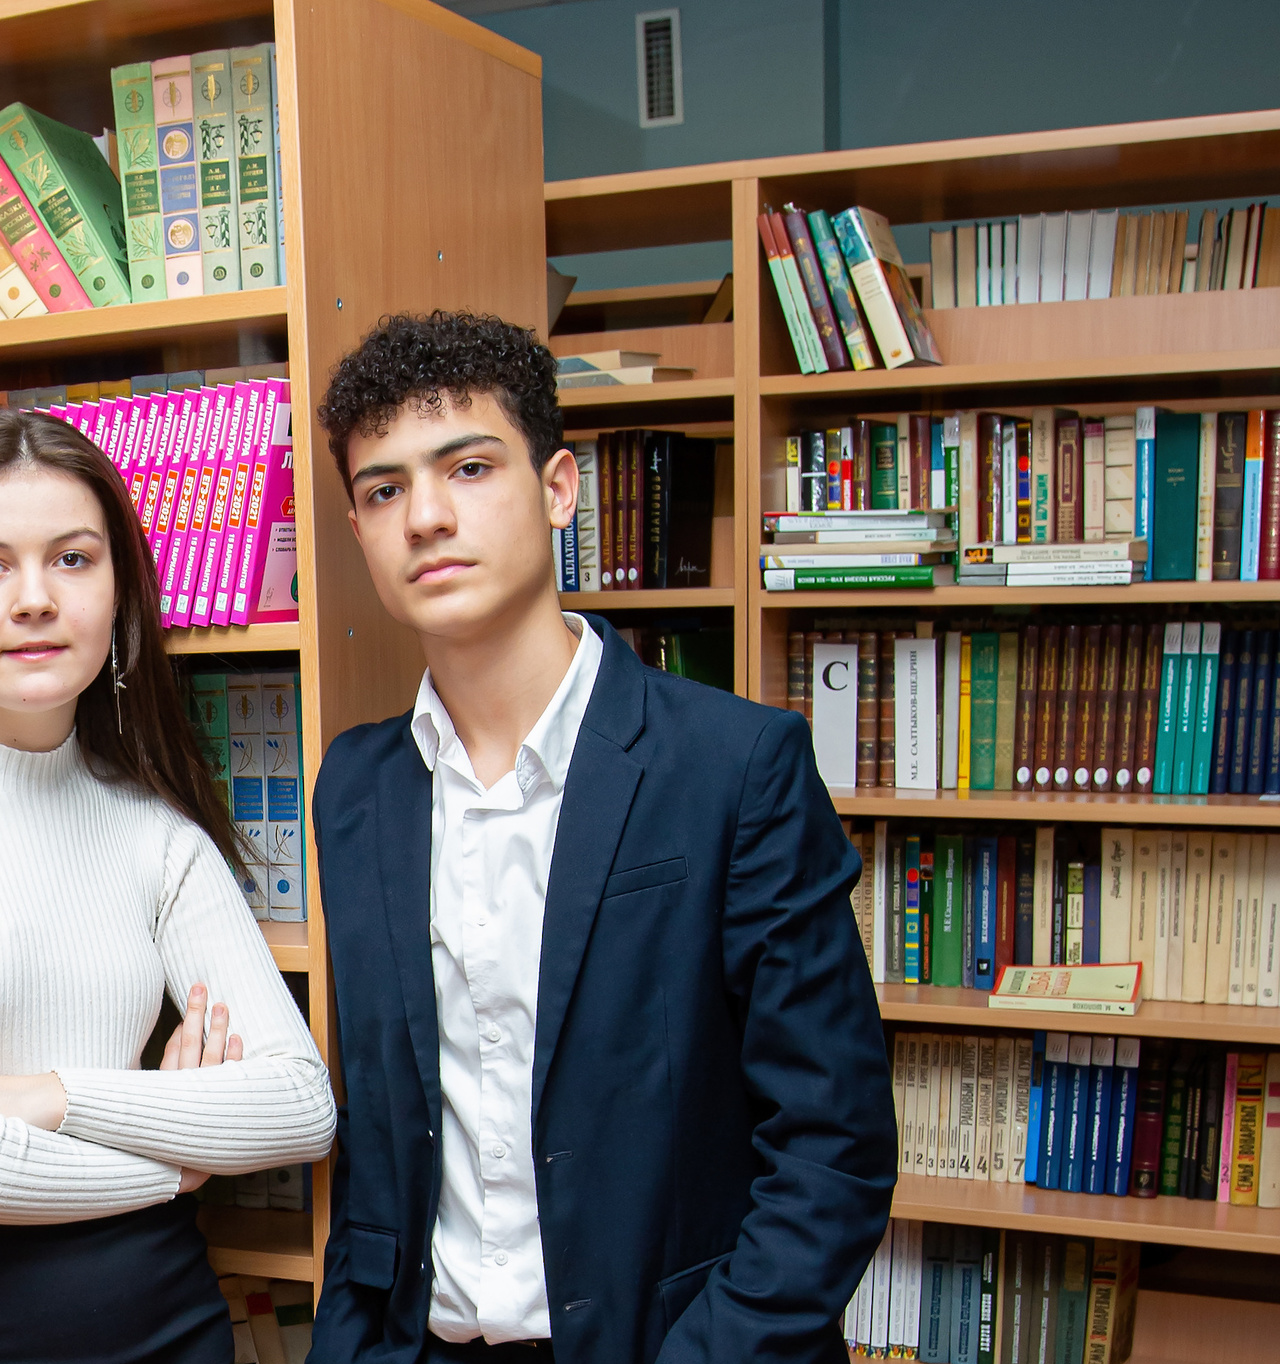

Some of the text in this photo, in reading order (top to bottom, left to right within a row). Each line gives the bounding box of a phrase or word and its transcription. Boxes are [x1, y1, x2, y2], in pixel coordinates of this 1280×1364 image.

[106, 409, 123, 462] ЛИТЕРАТУ
[120, 406, 140, 470] ЛИТЕРАТУРА
[138, 402, 158, 466] ЛИТЕРАТУРА
[155, 402, 175, 466] ЛИТЕРАТУРА
[172, 398, 192, 464] ЛИТЕРАТУРА
[190, 396, 209, 462] ЛИТЕРАТУРА
[206, 394, 226, 460] ЛИТЕРАТУРА
[224, 395, 244, 461] ЛИТЕРАТУРА
[241, 389, 259, 456] ЛИТЕРАТУРА
[259, 389, 276, 456] ЛИТЕРАТУРА
[131, 481, 142, 504] ЕГЭ-
[142, 480, 158, 528] ЕГЭ-2021
[159, 478, 175, 526] ЕГЭ-2021
[178, 476, 194, 524] ЕГЭ-2021
[194, 474, 211, 523] ЕГЭ-2021
[213, 475, 229, 524] ЕГЭ-2021
[231, 471, 246, 520] ЕГЭ-2021
[250, 471, 264, 520] ЕГЭ-2021
[650, 475, 661, 542] ПЛАТОНОВ
[166, 538, 181, 591] 15 ВАРИАНТОВ
[182, 536, 198, 591] 15 ВАРИАНТОВ
[201, 538, 216, 592] 15 ВАРИАНТОВ
[221, 534, 235, 588] 15 ВАРИАНТОВ
[240, 534, 254, 589] 15 ВАРИАНТОВ
[564, 518, 576, 586] А.ПЛАТОНО
[584, 572, 590, 582] 3
[822, 660, 850, 691] С
[910, 650, 918, 756] САЛТЫКОВ-ЩЕДРИН
[864, 846, 873, 966] ОСПОДА ГОЛОВЛЕВЫ
[1015, 1074, 1028, 1124] АРХИПЕЛАГ
[904, 1151, 909, 1163] 1
[916, 1153, 923, 1165] 2
[928, 1158, 934, 1168] 3
[940, 1159, 945, 1169] 3
[950, 1159, 955, 1169] 3
[960, 1154, 970, 1173] 4
[977, 1156, 987, 1174] 4
[994, 1152, 1004, 1170] 5
[1014, 1158, 1025, 1177] 7
[1235, 1104, 1256, 1192] СЕМЬЯ ЗВОНАРЕВЫХ
[1090, 1287, 1111, 1341] ЗВОНАРЕВЫХ
